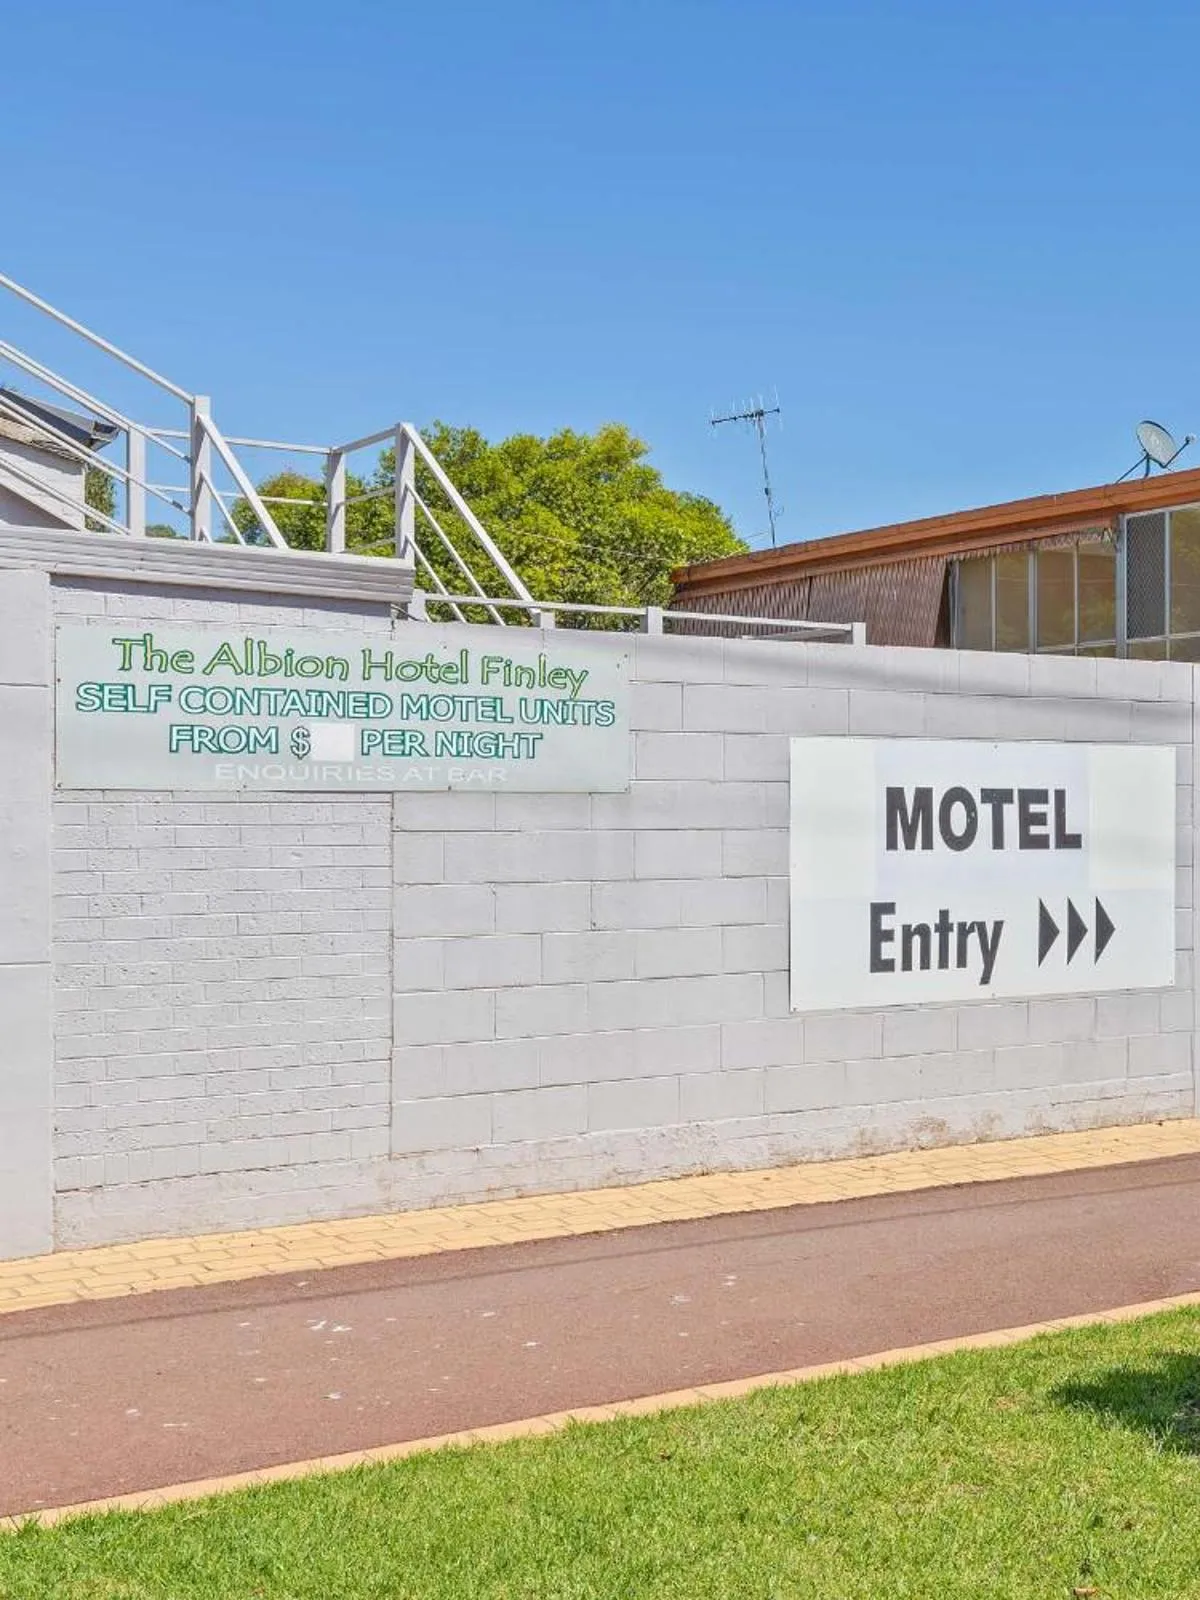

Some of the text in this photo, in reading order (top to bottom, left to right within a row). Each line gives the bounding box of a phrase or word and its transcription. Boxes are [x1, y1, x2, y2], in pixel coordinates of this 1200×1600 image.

[112, 634, 589, 698] The Albion Hotel Finley
[75, 681, 615, 727] SELF CONTAINED MOTEL UNITS
[169, 724, 279, 755] FROM
[361, 729, 431, 757] PER
[435, 731, 543, 759] NIGHT
[214, 764, 508, 784] ENQUIRIES AT BAR
[885, 786, 1083, 852] MOTEL
[869, 902, 1005, 986] Entry
